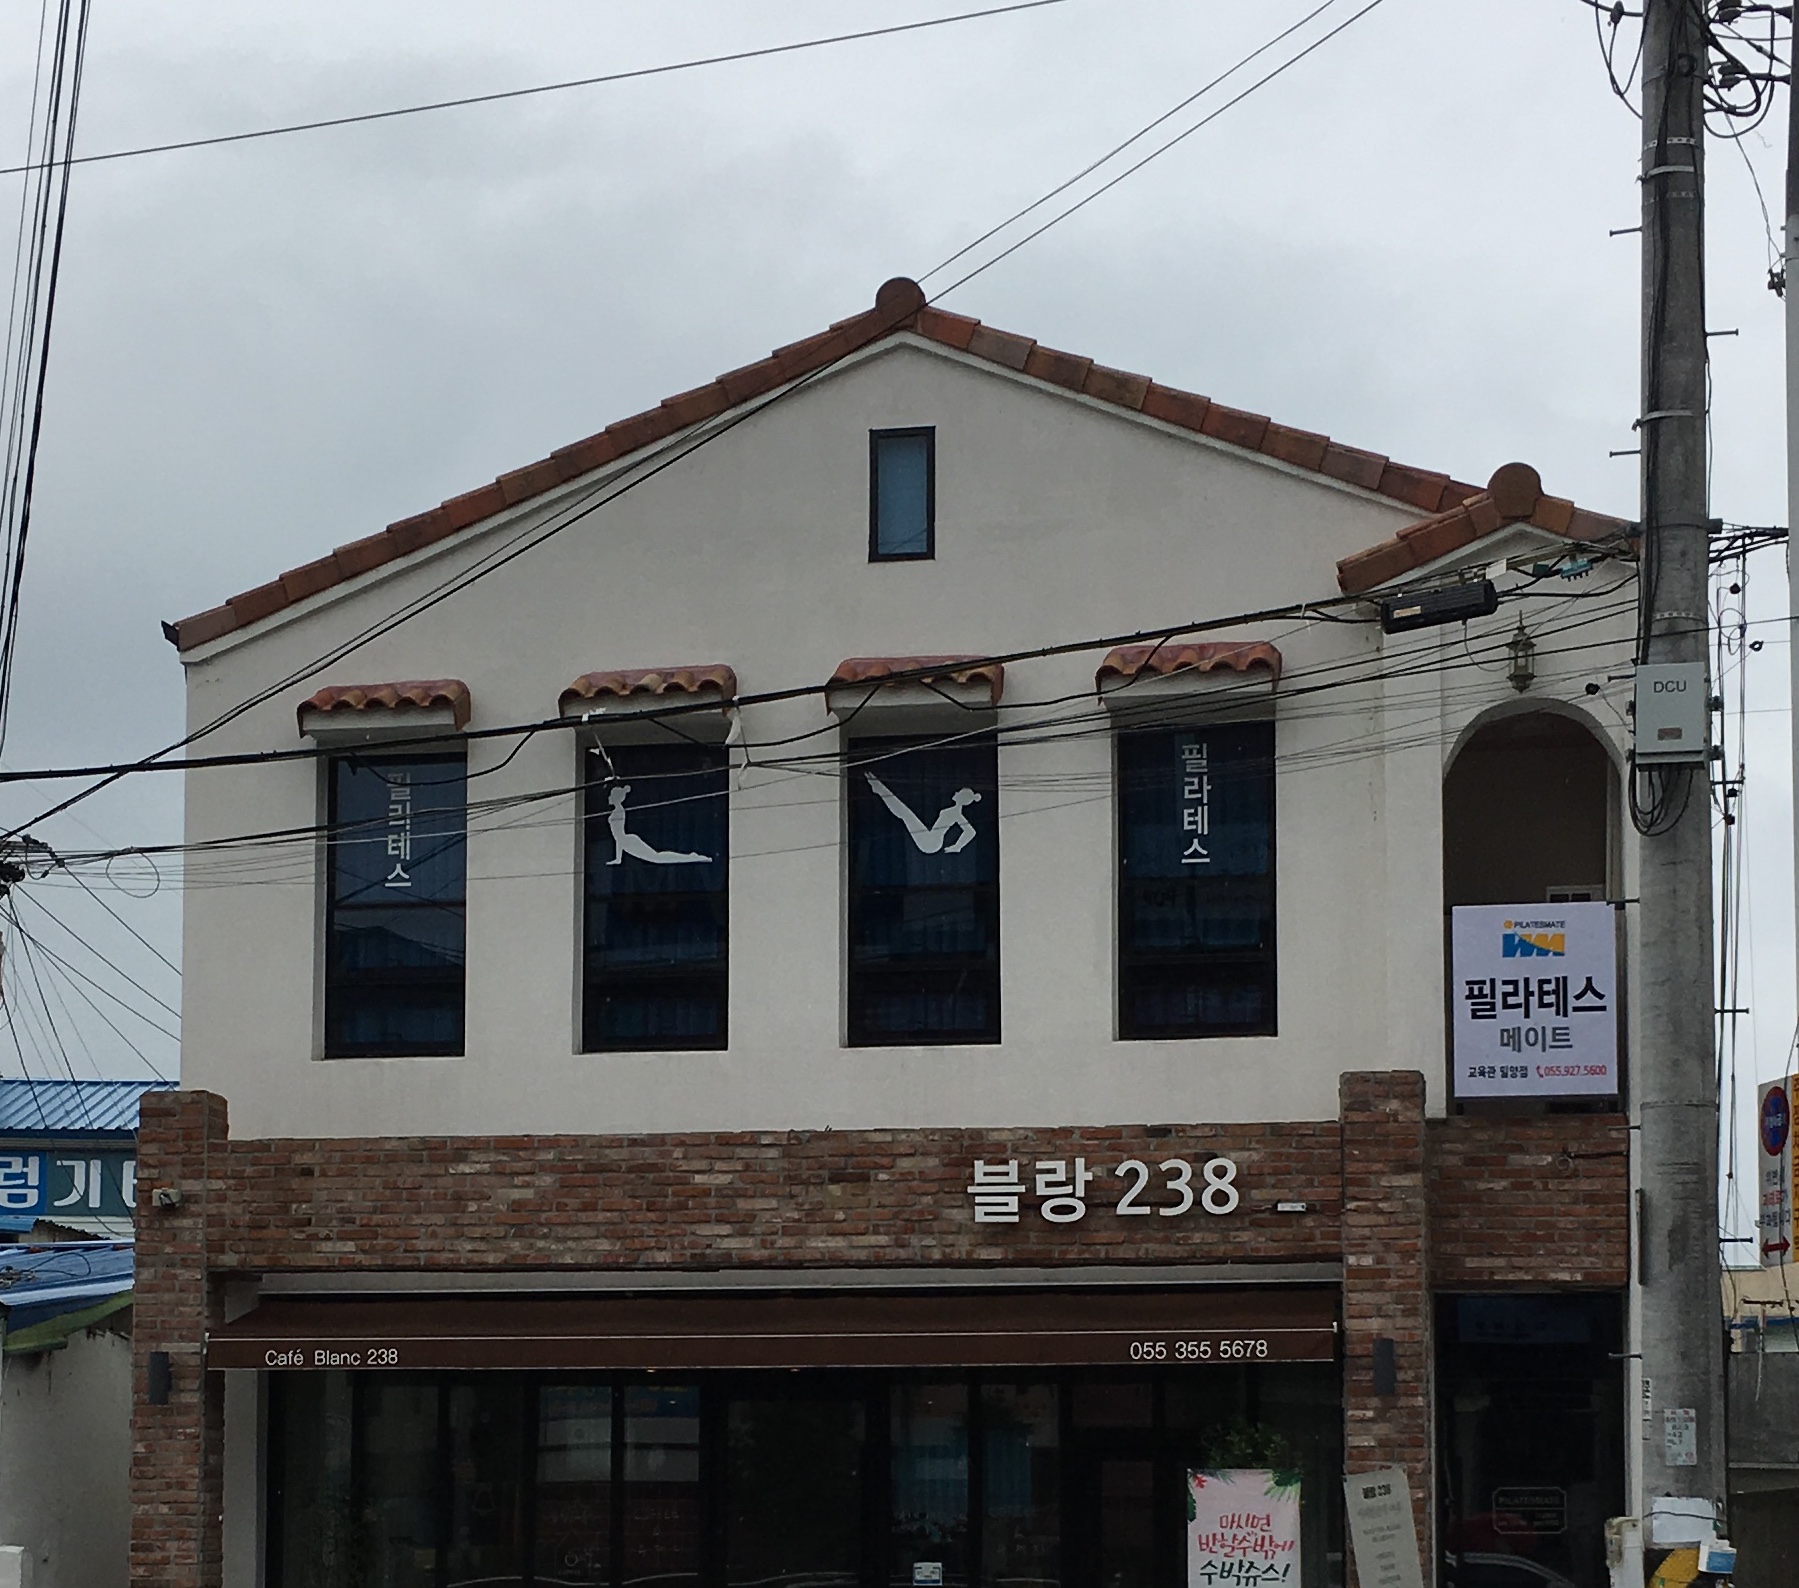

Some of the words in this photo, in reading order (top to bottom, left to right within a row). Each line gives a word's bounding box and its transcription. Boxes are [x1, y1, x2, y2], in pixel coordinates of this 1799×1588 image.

[1653, 680, 1687, 693] DCU
[1181, 743, 1212, 864] 필라테스
[1464, 976, 1607, 1020] 필라테스
[1499, 1025, 1573, 1053] 메이트
[967, 1157, 1093, 1223] 블랑
[1115, 1157, 1239, 1216] 238
[265, 1348, 304, 1367] Café
[314, 1348, 361, 1366] Blanc
[366, 1348, 398, 1365] 238
[1130, 1341, 1167, 1360] 055
[1174, 1340, 1212, 1359] 355
[1219, 1339, 1268, 1358] 5678
[1219, 1512, 1272, 1532] 마시면
[1199, 1559, 1291, 1586] 수박쥬스!
